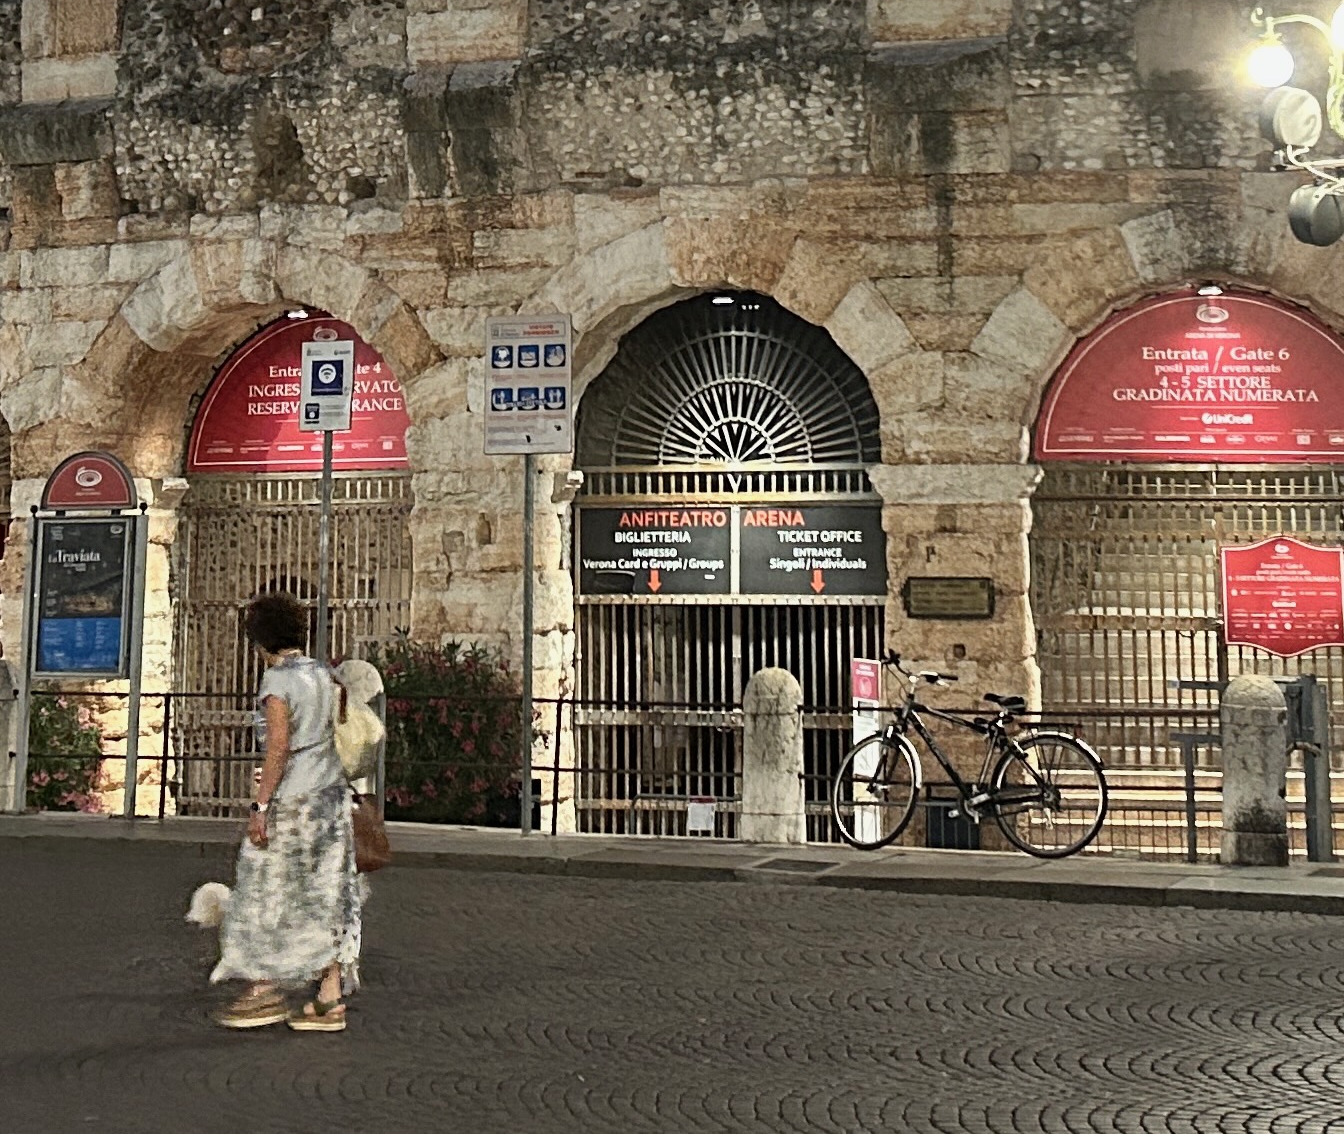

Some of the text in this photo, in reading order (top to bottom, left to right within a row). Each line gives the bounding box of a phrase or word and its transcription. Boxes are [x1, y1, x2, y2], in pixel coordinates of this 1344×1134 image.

[1141, 346, 1209, 360] Entrata
[1229, 346, 1274, 361] Gate
[1278, 347, 1290, 360] 6
[372, 361, 382, 374] 4
[1155, 362, 1183, 376] posti
[1159, 375, 1169, 388] 4
[1181, 375, 1191, 388] 5
[1196, 375, 1272, 389] SETTORE
[248, 383, 301, 397] INGRES
[1112, 388, 1320, 403] GRADINATA NUMERATA
[247, 401, 301, 415] RESERV
[352, 397, 403, 412] RANCE
[619, 510, 727, 528] ANFITEATRO
[743, 509, 806, 527] ARENA
[614, 530, 692, 544] BIGLIETTERIA
[777, 530, 863, 543] TICKET OFFICE
[56, 548, 101, 564] Traviata
[632, 547, 678, 558] INGRESSO
[792, 547, 843, 558] ENTRANCE
[583, 558, 617, 569] Verona
[617, 557, 641, 569] Card
[641, 559, 649, 569] e
[649, 557, 682, 572] Gruppi
[688, 557, 725, 572] Groups
[769, 557, 805, 572] Singoli
[812, 557, 868, 570] Individuals
